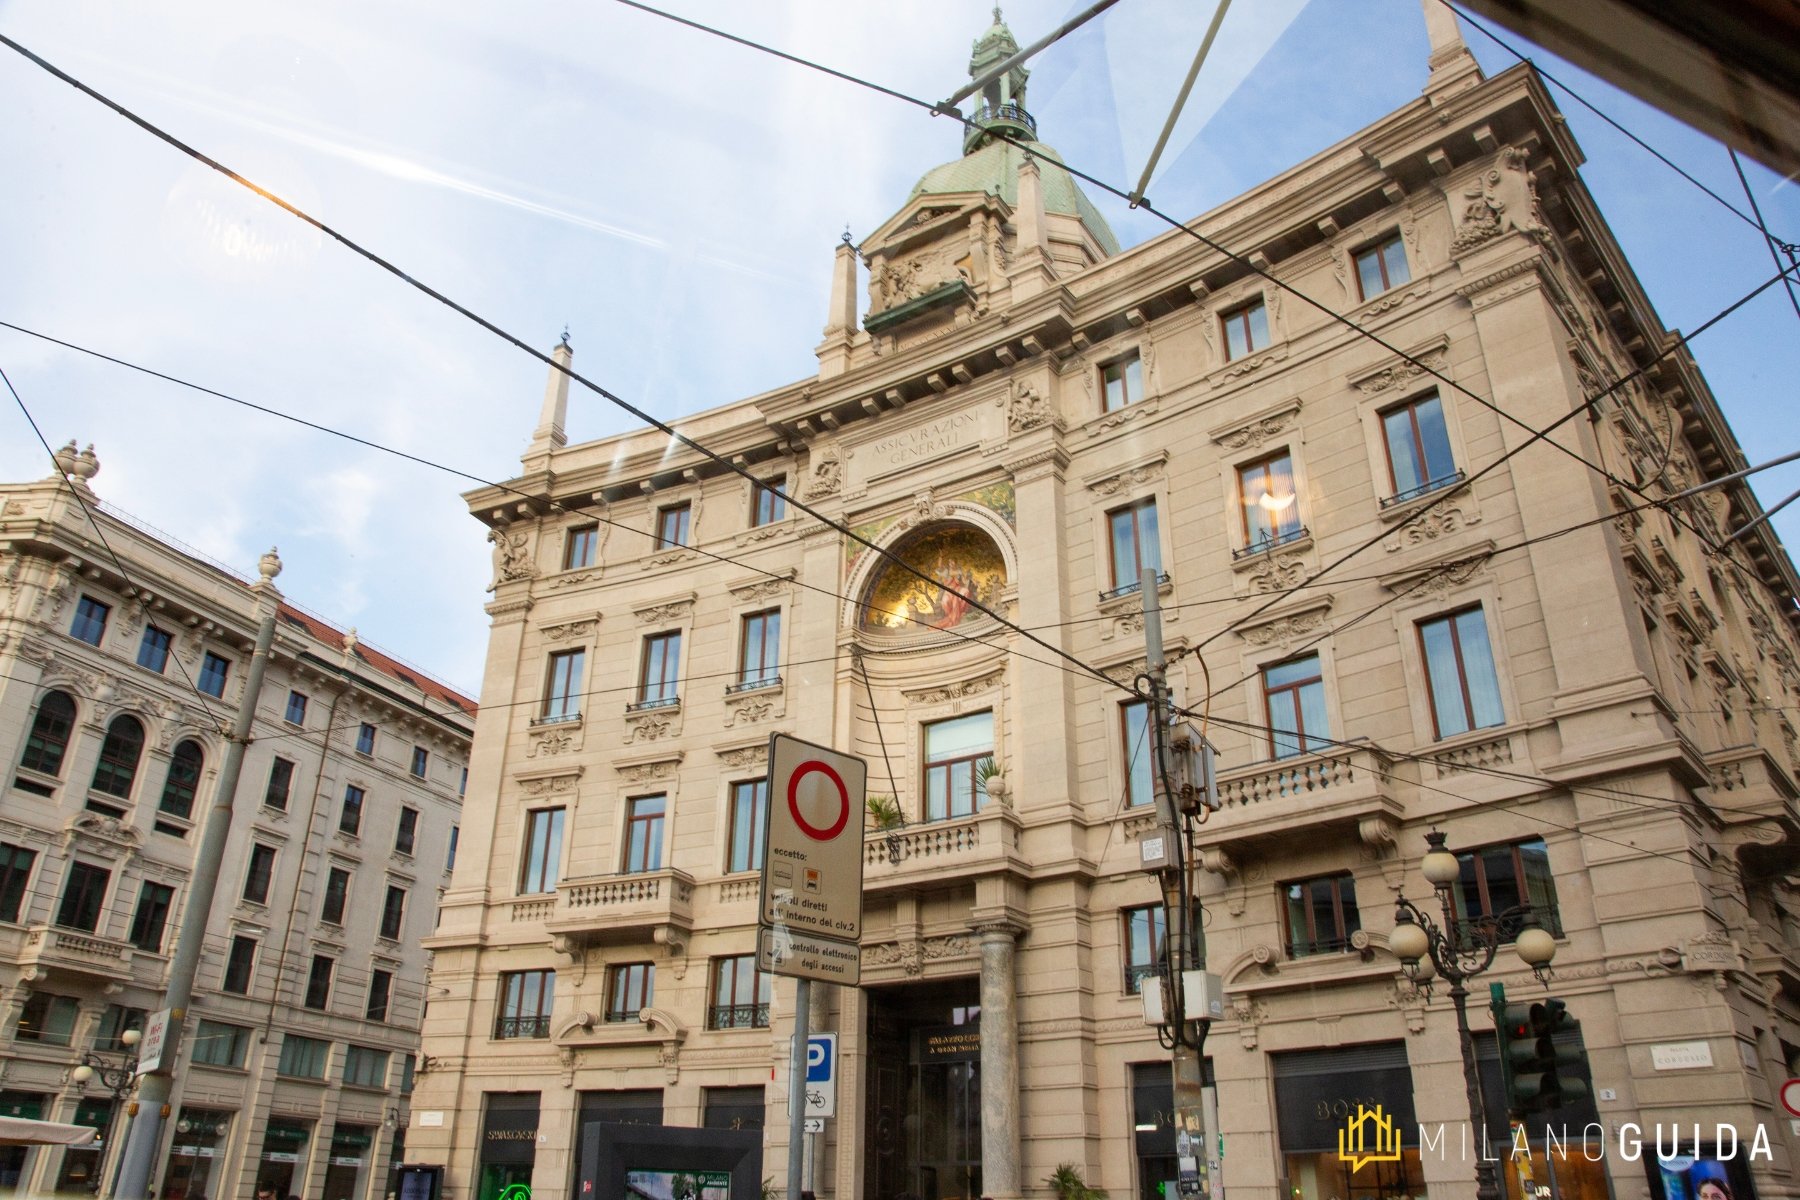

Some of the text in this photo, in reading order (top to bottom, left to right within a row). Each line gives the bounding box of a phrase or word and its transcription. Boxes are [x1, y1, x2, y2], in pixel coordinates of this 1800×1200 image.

[890, 431, 958, 464] GENERALI
[774, 848, 807, 861] eccetto:
[802, 898, 827, 911] diretti
[786, 911, 817, 924] interno
[819, 917, 833, 927] del
[789, 943, 858, 961] controllo elettronico
[801, 959, 844, 973] degli accessi
[806, 1043, 825, 1078] P
